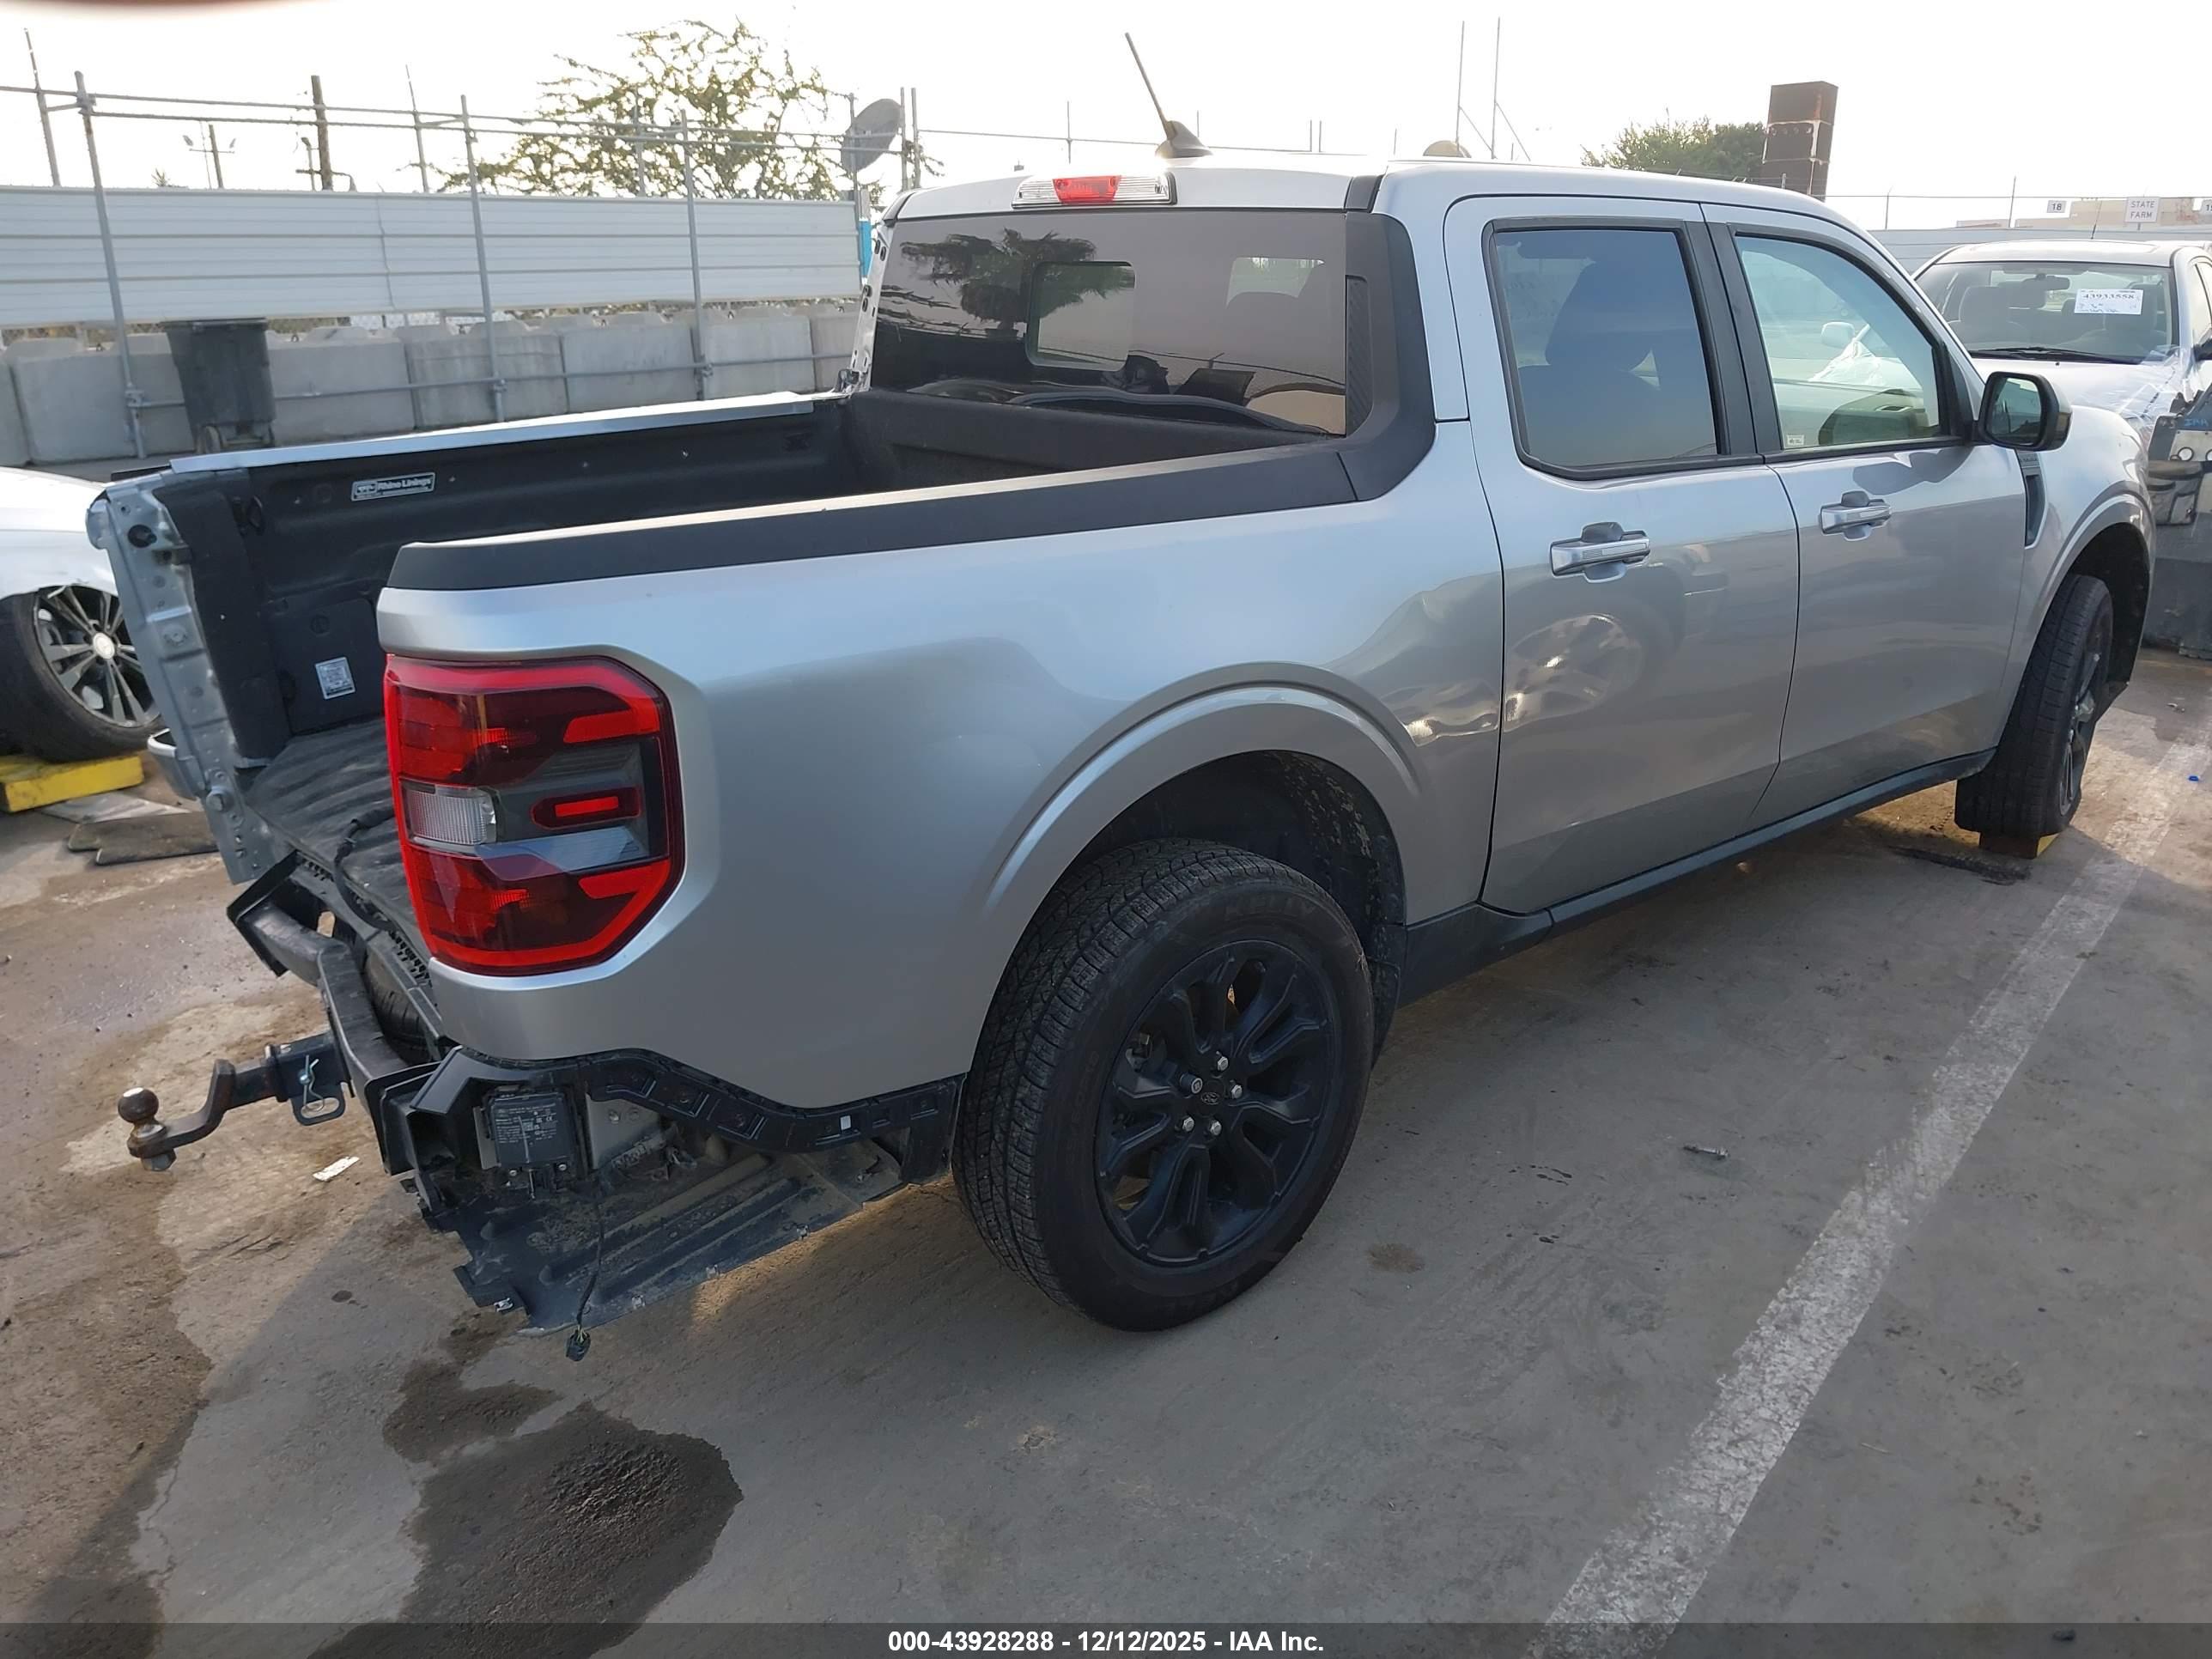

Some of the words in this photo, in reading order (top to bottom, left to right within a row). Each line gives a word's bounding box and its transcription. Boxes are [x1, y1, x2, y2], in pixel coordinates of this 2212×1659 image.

[2051, 203, 2062, 211] 18
[2130, 200, 2155, 209] STATE
[378, 481, 402, 490] Rhino
